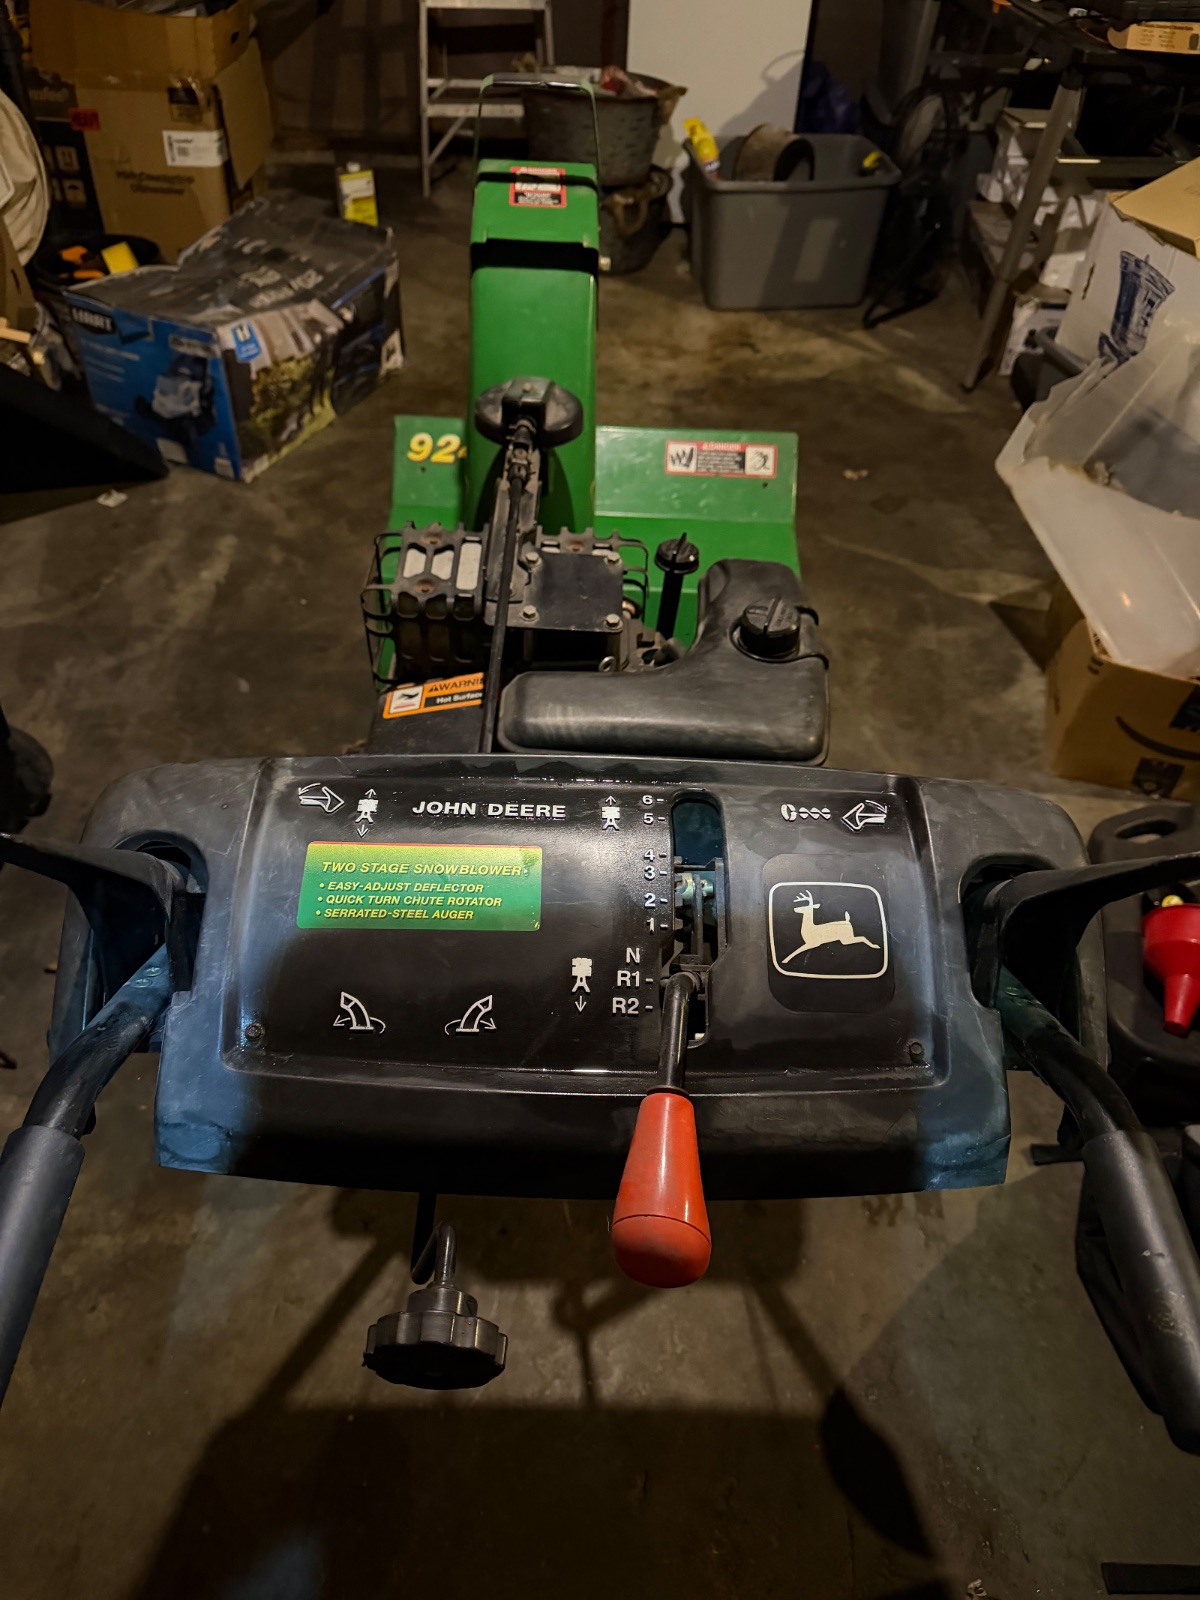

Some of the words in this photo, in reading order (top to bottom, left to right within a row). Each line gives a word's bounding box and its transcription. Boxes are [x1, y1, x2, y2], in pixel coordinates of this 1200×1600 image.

[406, 431, 468, 464] 92
[436, 695, 452, 705] Hot
[641, 794, 653, 805] 6
[412, 800, 476, 816] JOHN
[487, 803, 566, 819] DEERE
[643, 812, 654, 824] 5
[643, 848, 656, 861] 4
[322, 861, 356, 873] TWO
[360, 862, 409, 875] STAGE
[413, 863, 522, 877] SNOWBLOWER
[644, 866, 656, 880] 3
[327, 881, 410, 892] EASY-ADJUST
[413, 883, 484, 893] DEFLECTOR
[325, 894, 363, 906] QUICK
[367, 895, 401, 906] TURN
[403, 896, 443, 907] CHUTE
[446, 896, 503, 908] ROTATOR
[644, 892, 656, 908] 2
[431, 909, 475, 921] AUGER
[646, 917, 656, 934] 1
[626, 947, 641, 964] N
[616, 969, 641, 988] R1
[612, 997, 640, 1015] R2
